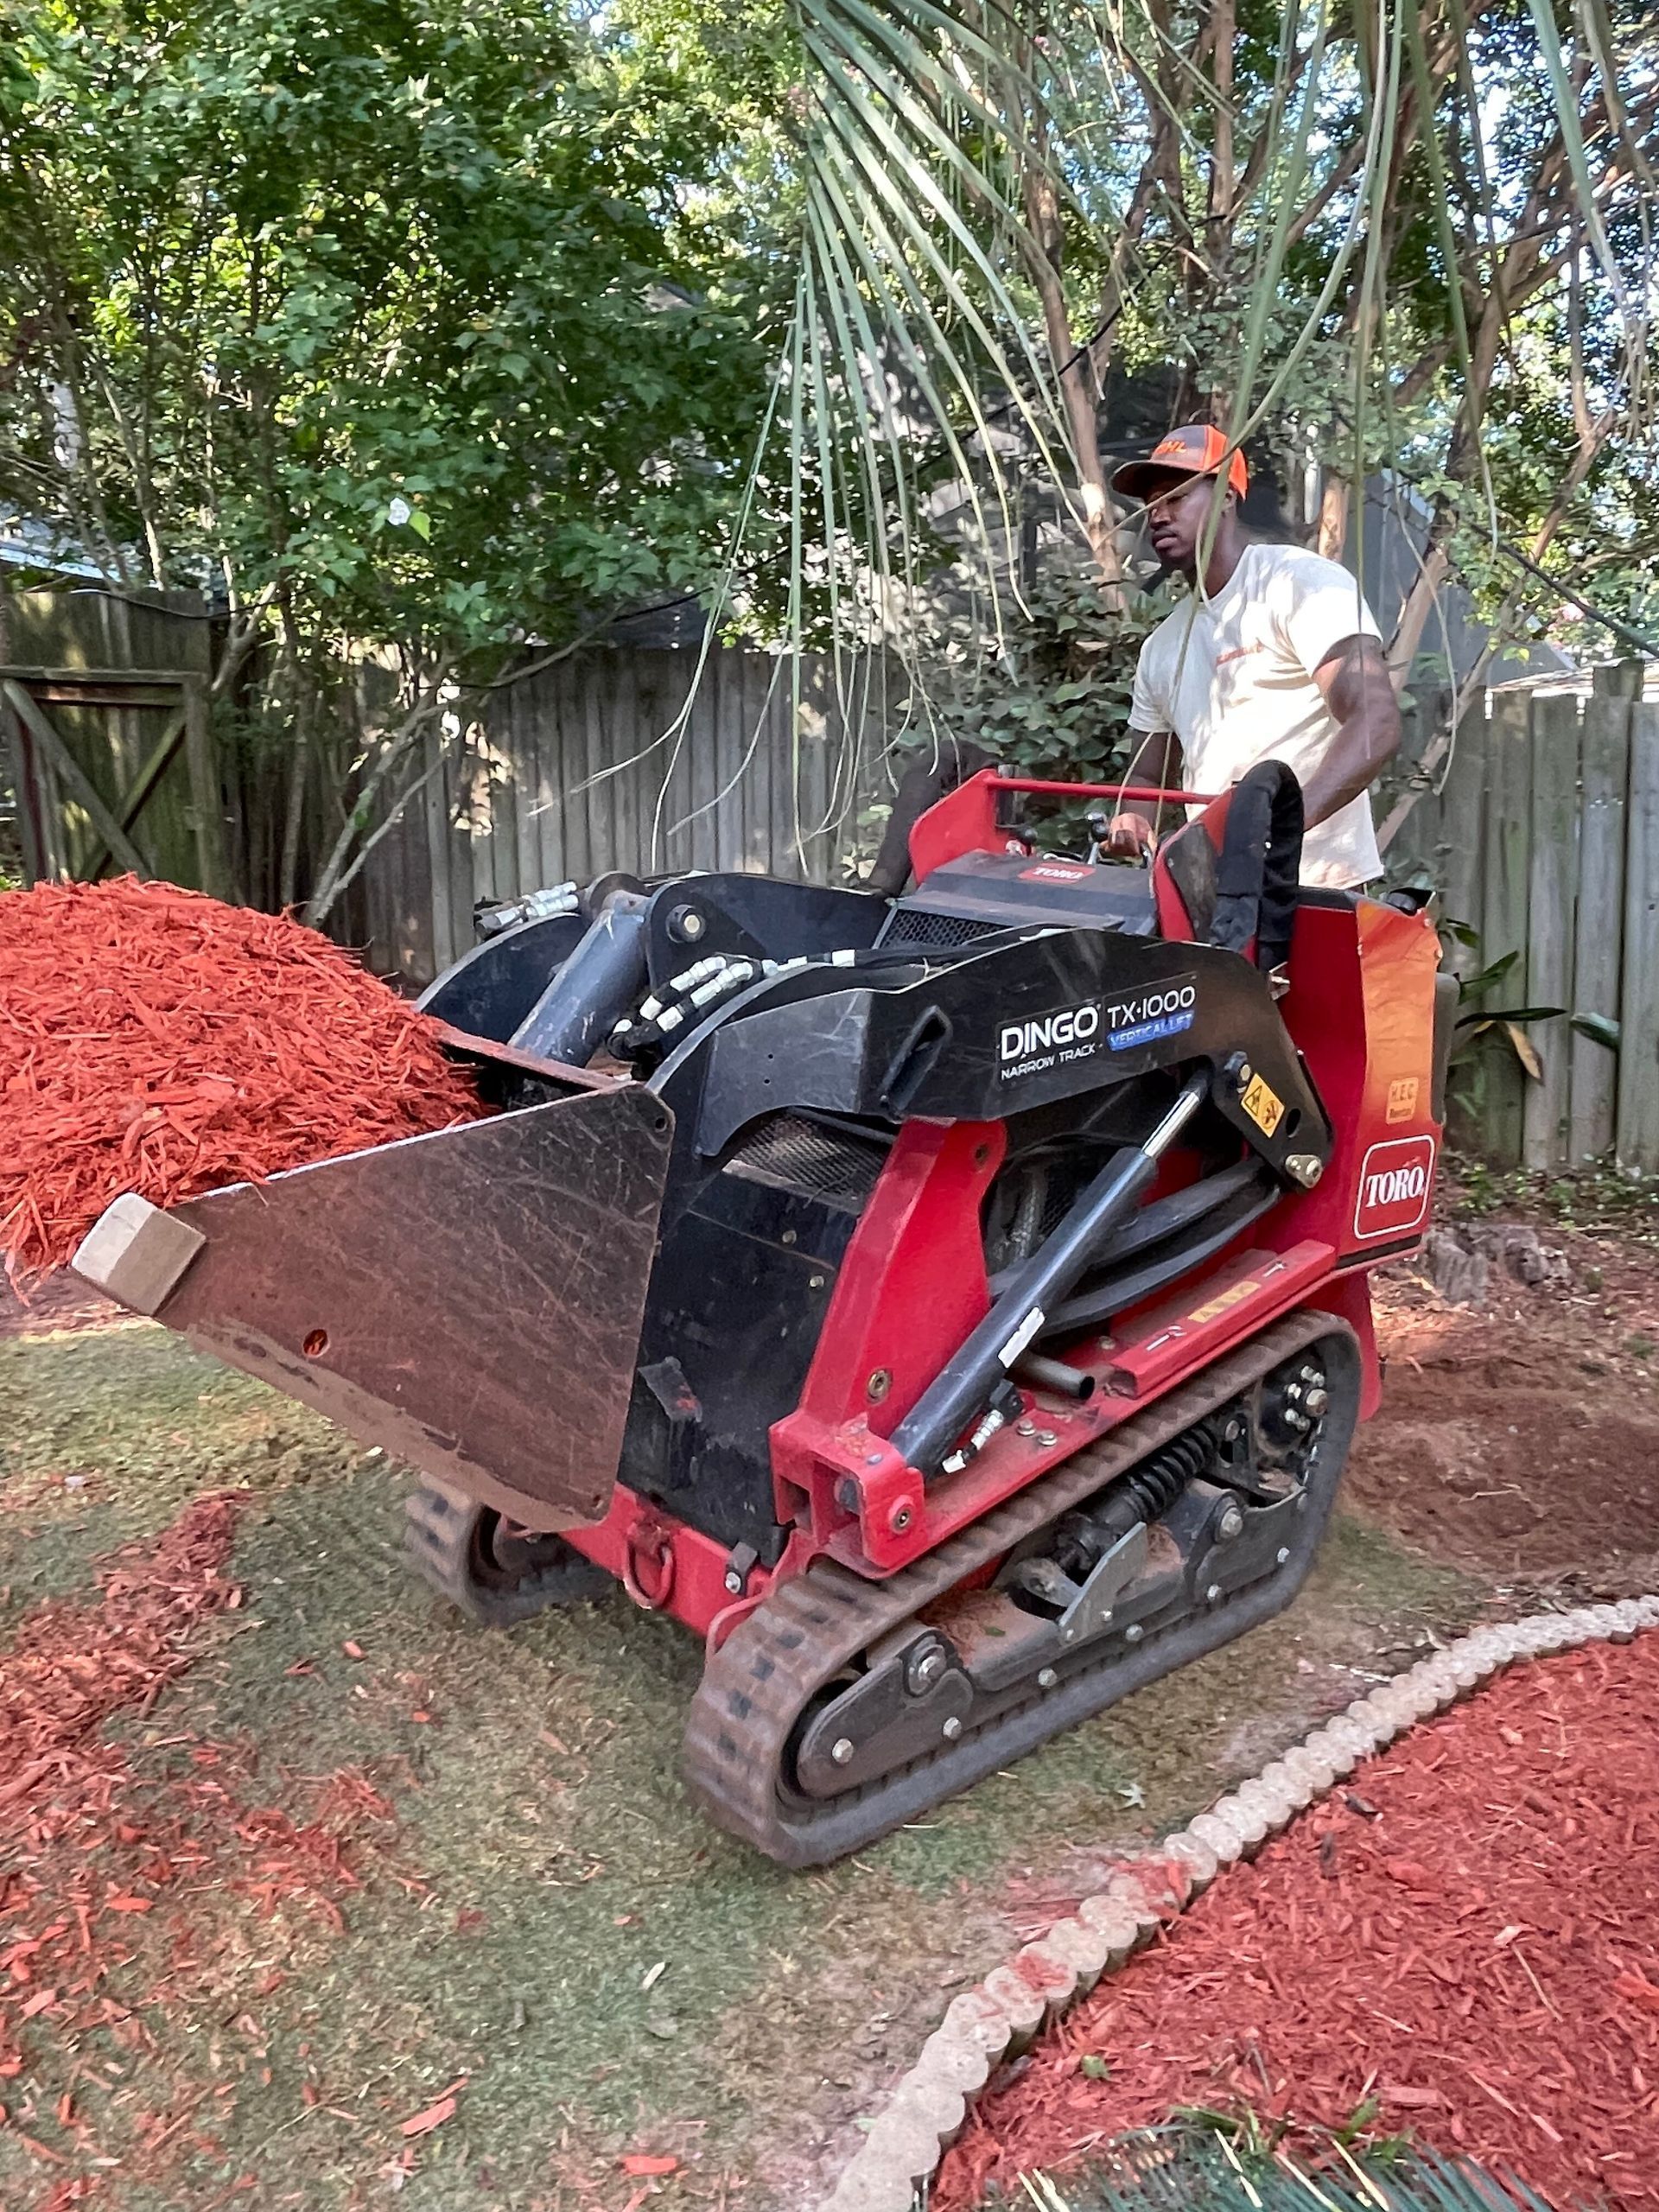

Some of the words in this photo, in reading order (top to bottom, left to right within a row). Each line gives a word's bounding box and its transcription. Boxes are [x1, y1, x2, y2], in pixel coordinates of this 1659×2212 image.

[1033, 867, 1084, 880] TORO
[1001, 1006, 1098, 1059] DINGO
[1001, 1055, 1055, 1080] NARROW
[1058, 1043, 1096, 1063] TRACK
[1365, 1166, 1424, 1207] TORO
